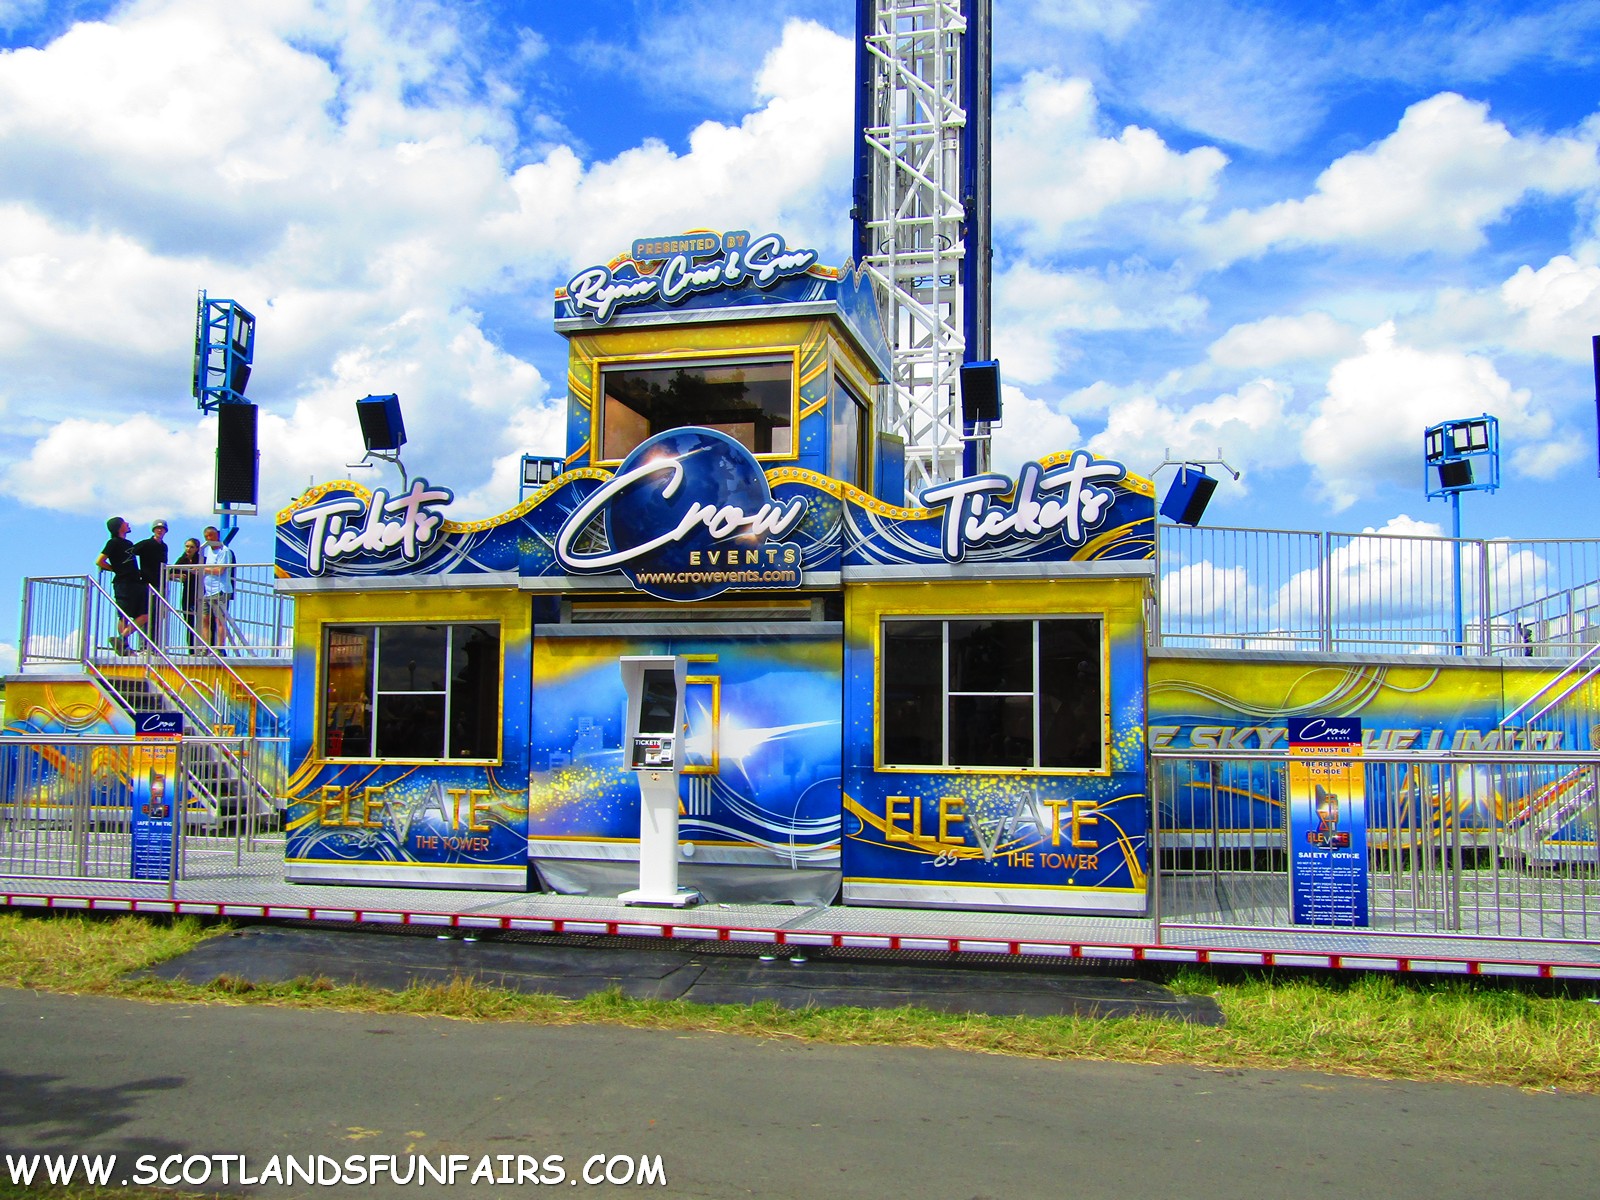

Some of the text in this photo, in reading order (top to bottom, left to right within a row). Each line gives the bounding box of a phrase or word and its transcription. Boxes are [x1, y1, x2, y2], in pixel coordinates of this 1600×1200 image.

[637, 235, 746, 254] PRESENTED BY
[570, 268, 657, 319] Ryan
[662, 255, 721, 294] Crow
[744, 237, 814, 280] Son
[558, 459, 802, 569] Crow
[923, 454, 1121, 557] Tickets
[293, 481, 450, 572] Tickets
[689, 548, 796, 567] EVENTS
[636, 569, 796, 585] www.crowevents.com
[142, 714, 176, 731] Crow
[1299, 719, 1351, 740] Crow
[1190, 726, 1288, 749] SKY
[1362, 729, 1421, 750] HE
[320, 779, 491, 844] ELEVATE
[885, 790, 1099, 863] ELEVATE
[415, 835, 490, 852] THE TOWER
[1007, 852, 1099, 870] THE TOWER
